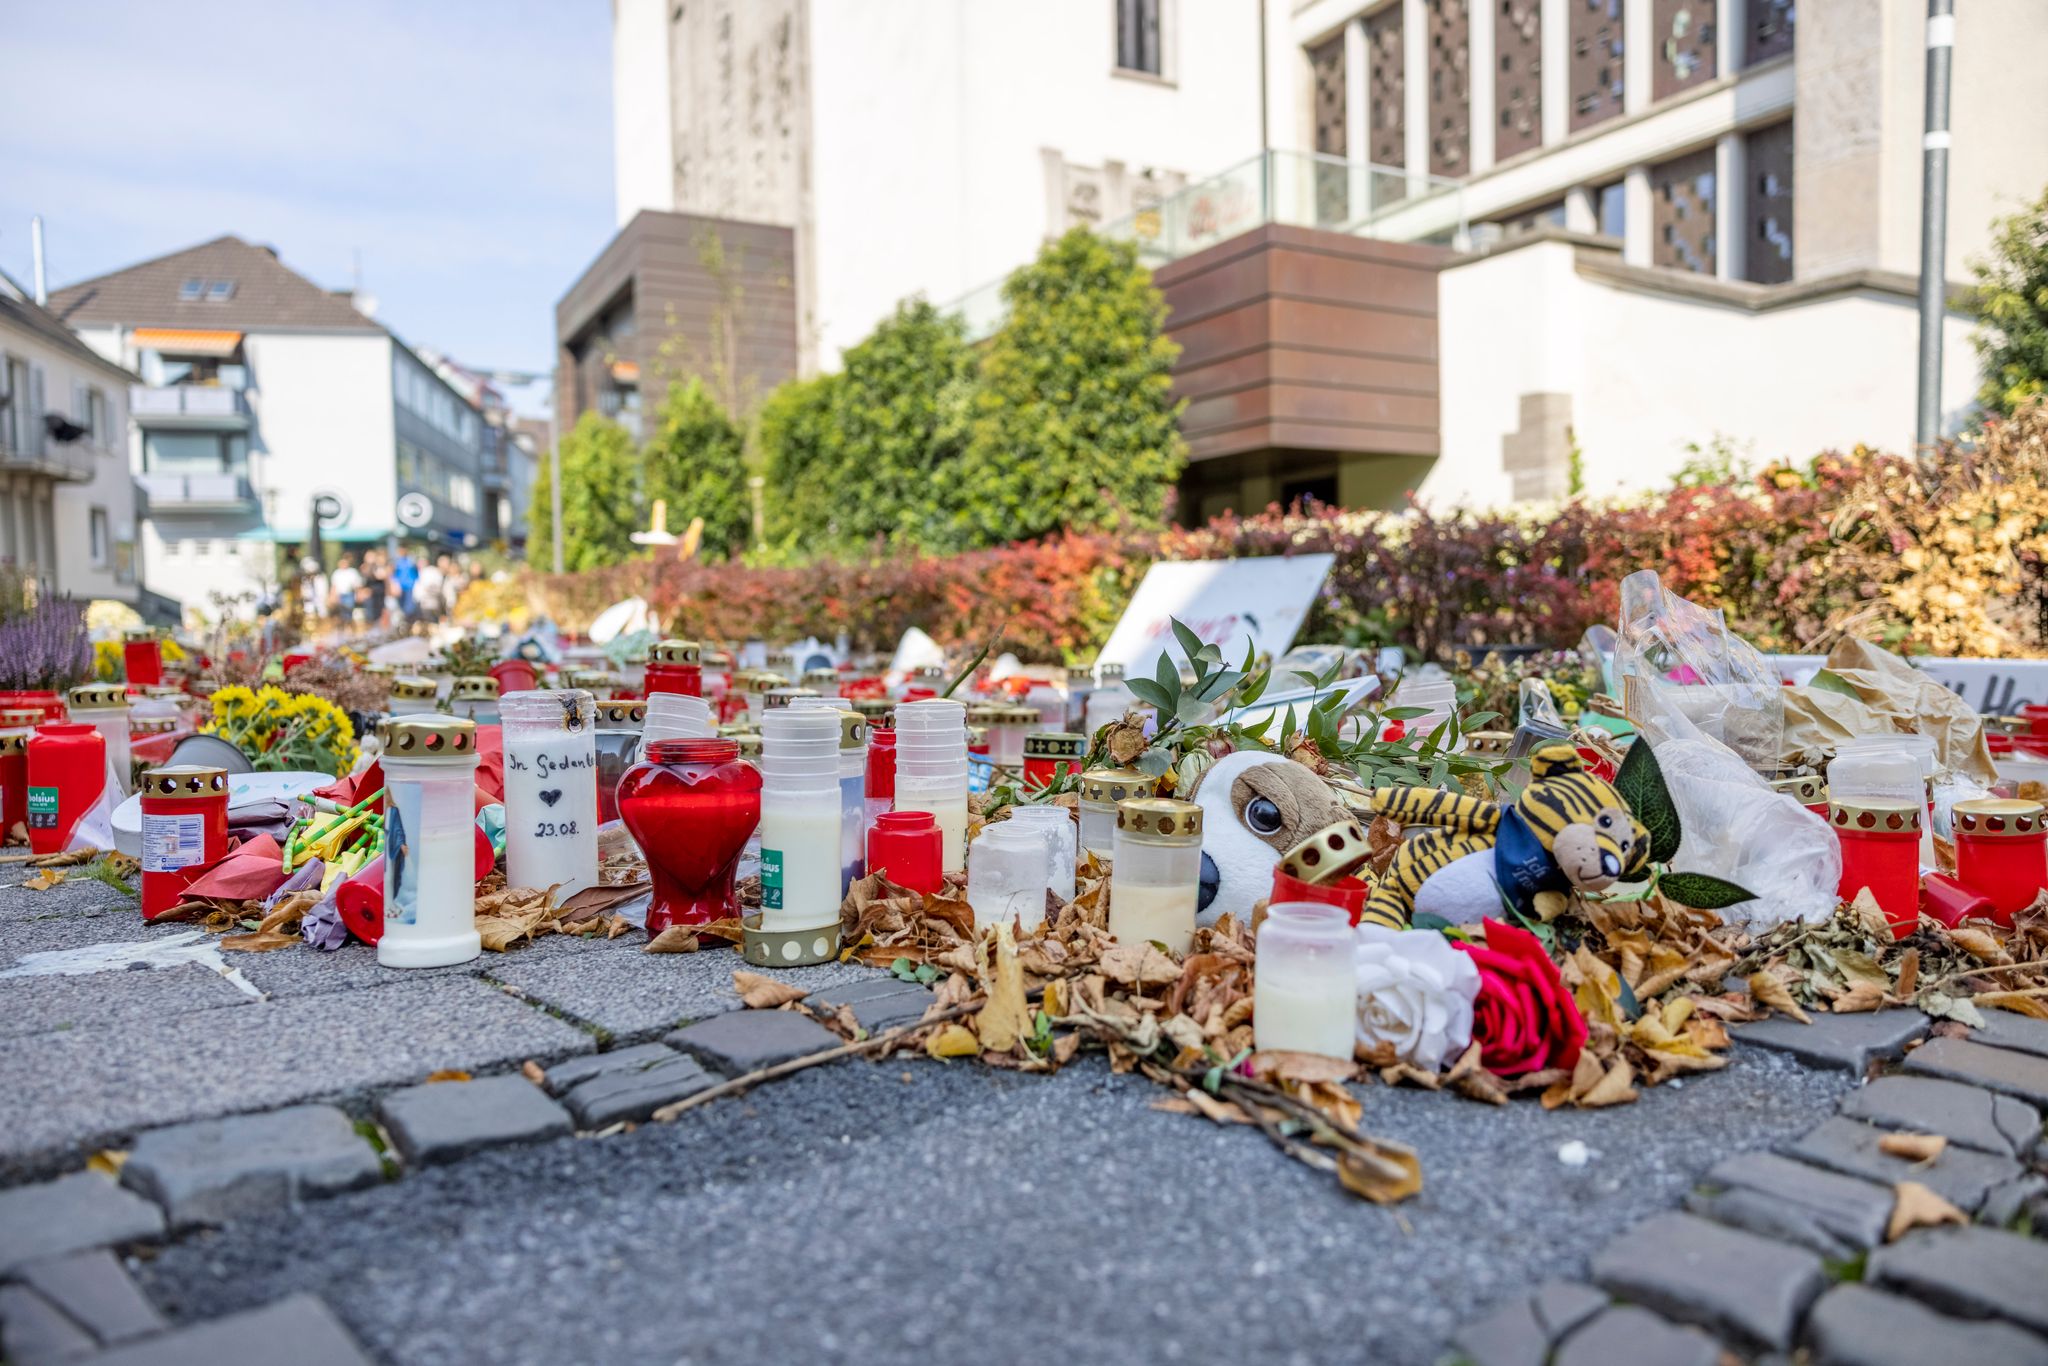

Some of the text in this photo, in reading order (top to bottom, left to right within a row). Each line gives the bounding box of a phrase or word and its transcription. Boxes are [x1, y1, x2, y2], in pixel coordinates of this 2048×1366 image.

[509, 753, 528, 771] In
[534, 820, 580, 837] 23.08.
[1522, 856, 1551, 879] Ich
